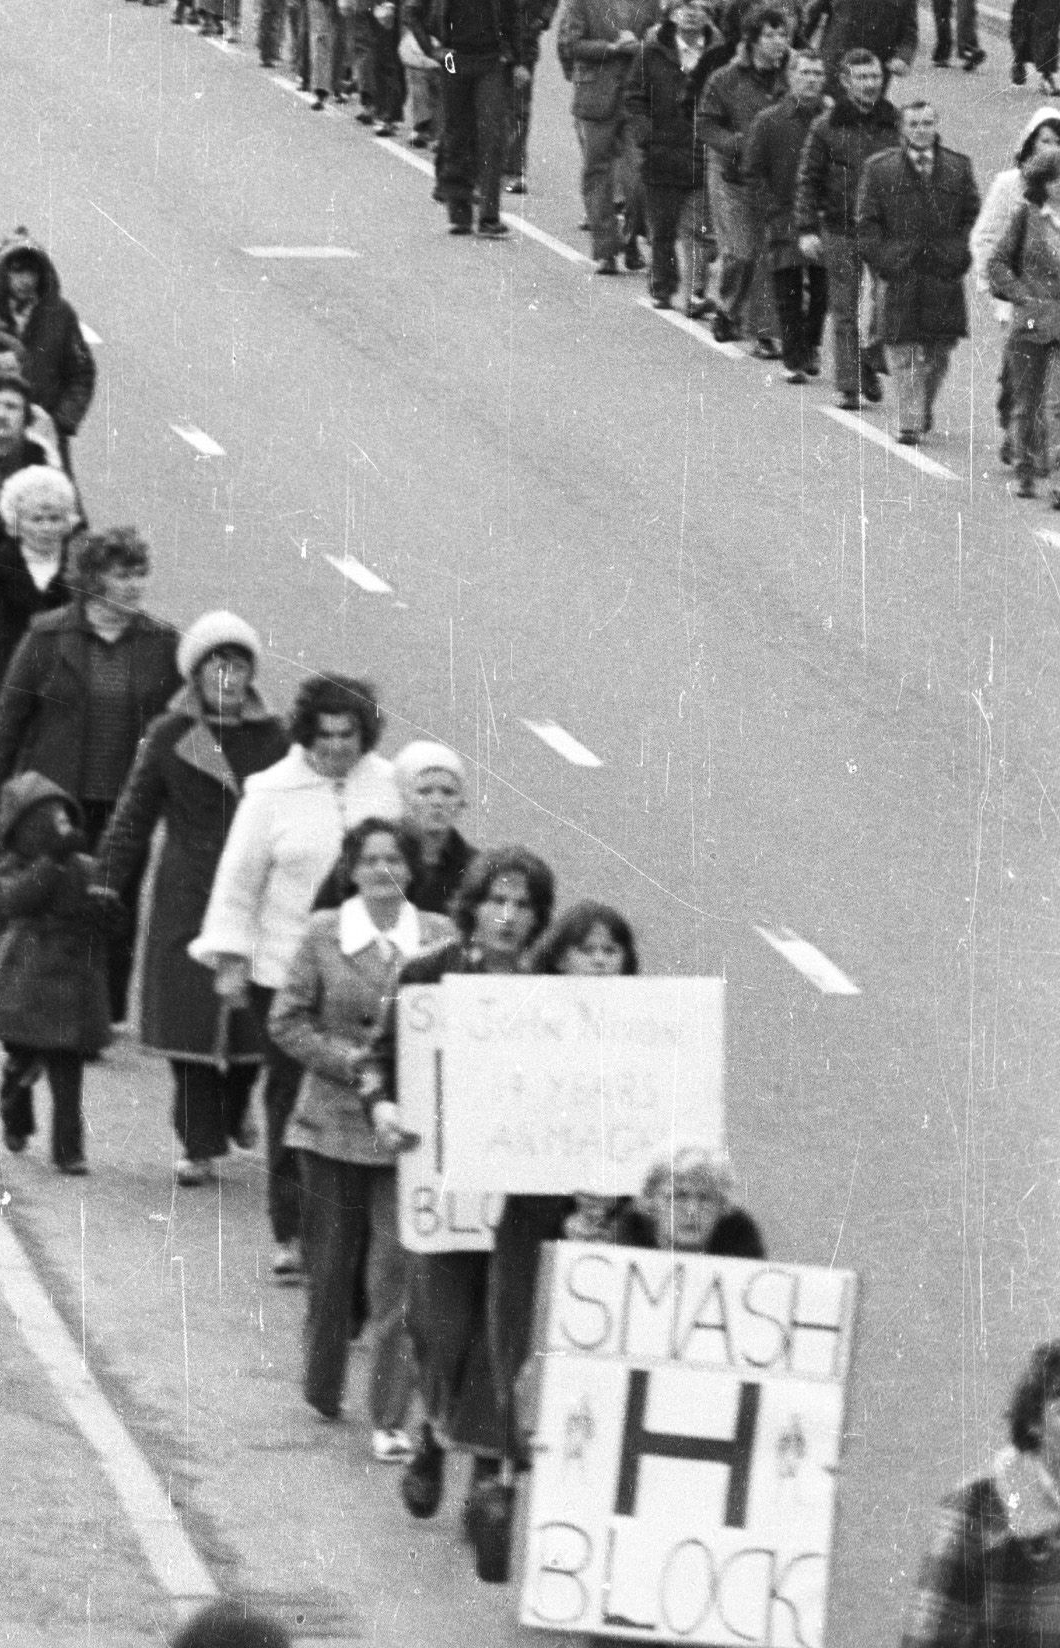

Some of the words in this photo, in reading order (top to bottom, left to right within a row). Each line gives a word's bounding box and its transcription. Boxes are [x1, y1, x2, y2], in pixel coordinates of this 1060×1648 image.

[561, 1253, 850, 1380] SMASH
[613, 1368, 762, 1530] H
[530, 1520, 827, 1648] BLOCK
